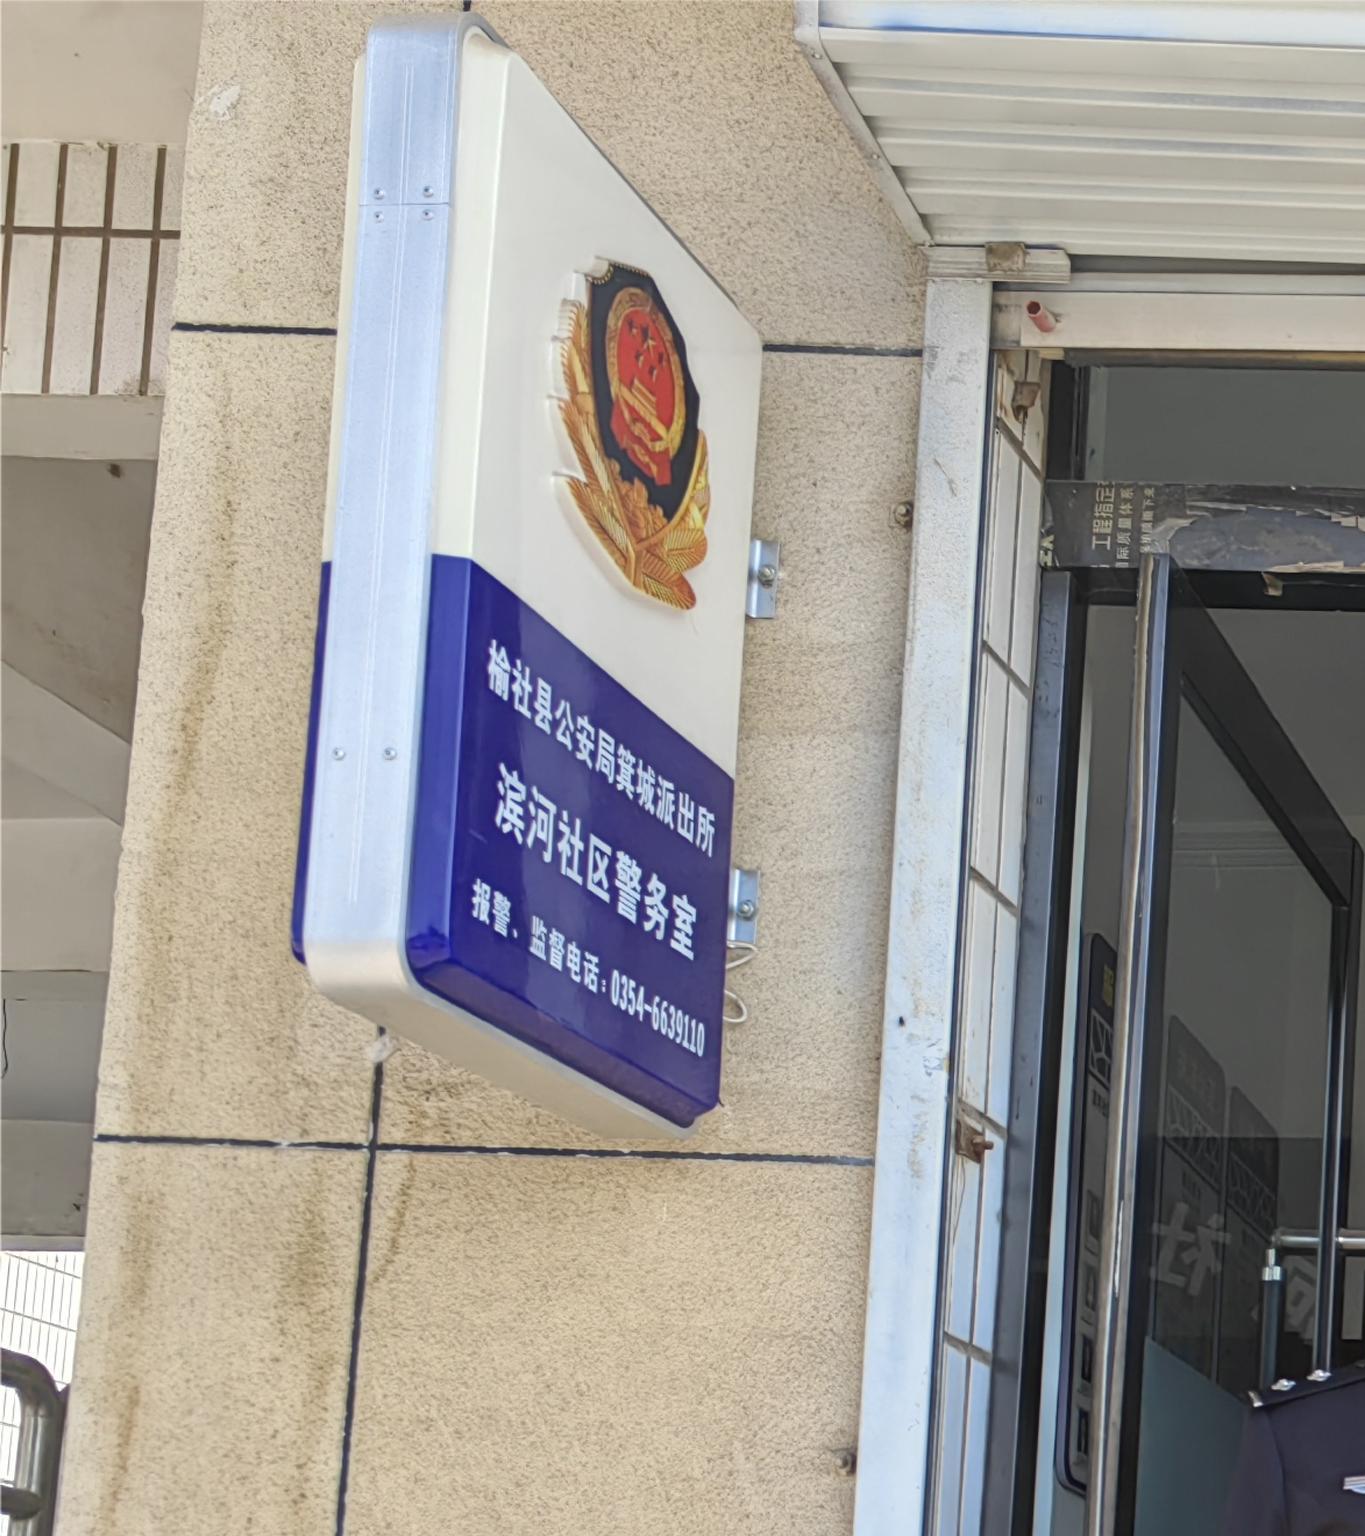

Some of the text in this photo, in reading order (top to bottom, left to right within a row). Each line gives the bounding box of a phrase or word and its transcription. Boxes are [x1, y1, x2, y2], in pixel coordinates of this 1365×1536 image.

[486, 640, 716, 859] 榆社县公安局箕城派出所
[494, 763, 698, 961] 滨河社区警务室
